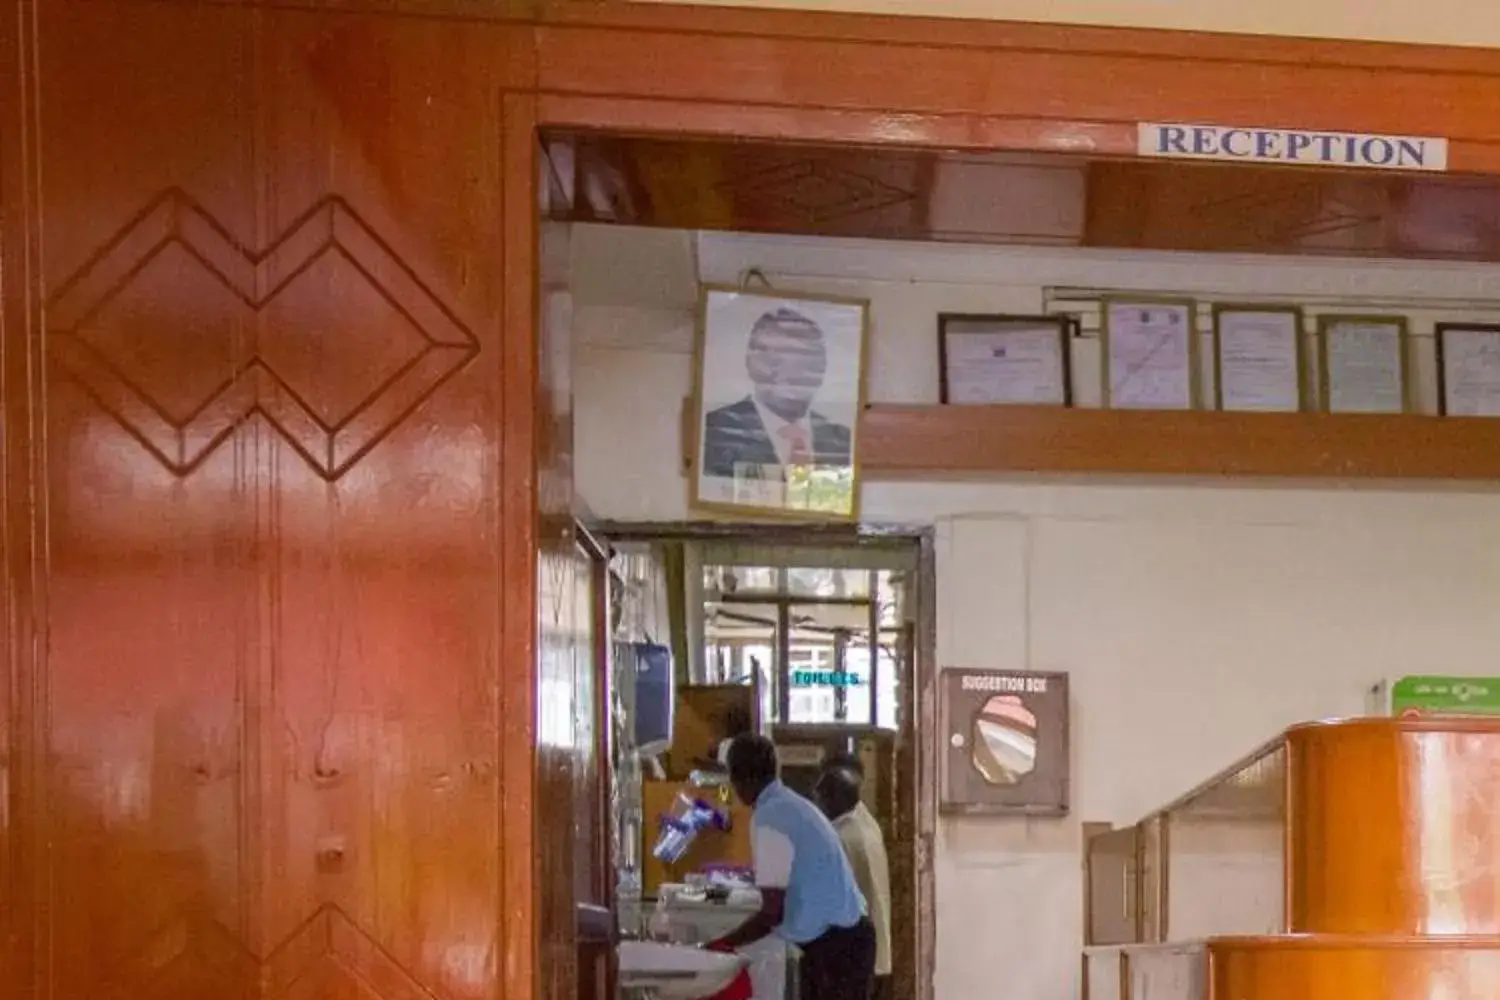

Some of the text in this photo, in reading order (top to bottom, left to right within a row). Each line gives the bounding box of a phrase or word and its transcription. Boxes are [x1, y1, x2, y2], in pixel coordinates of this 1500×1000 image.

[1157, 126, 1425, 167] RECEPTION
[962, 675, 1048, 693] SUGGESTION BOX
